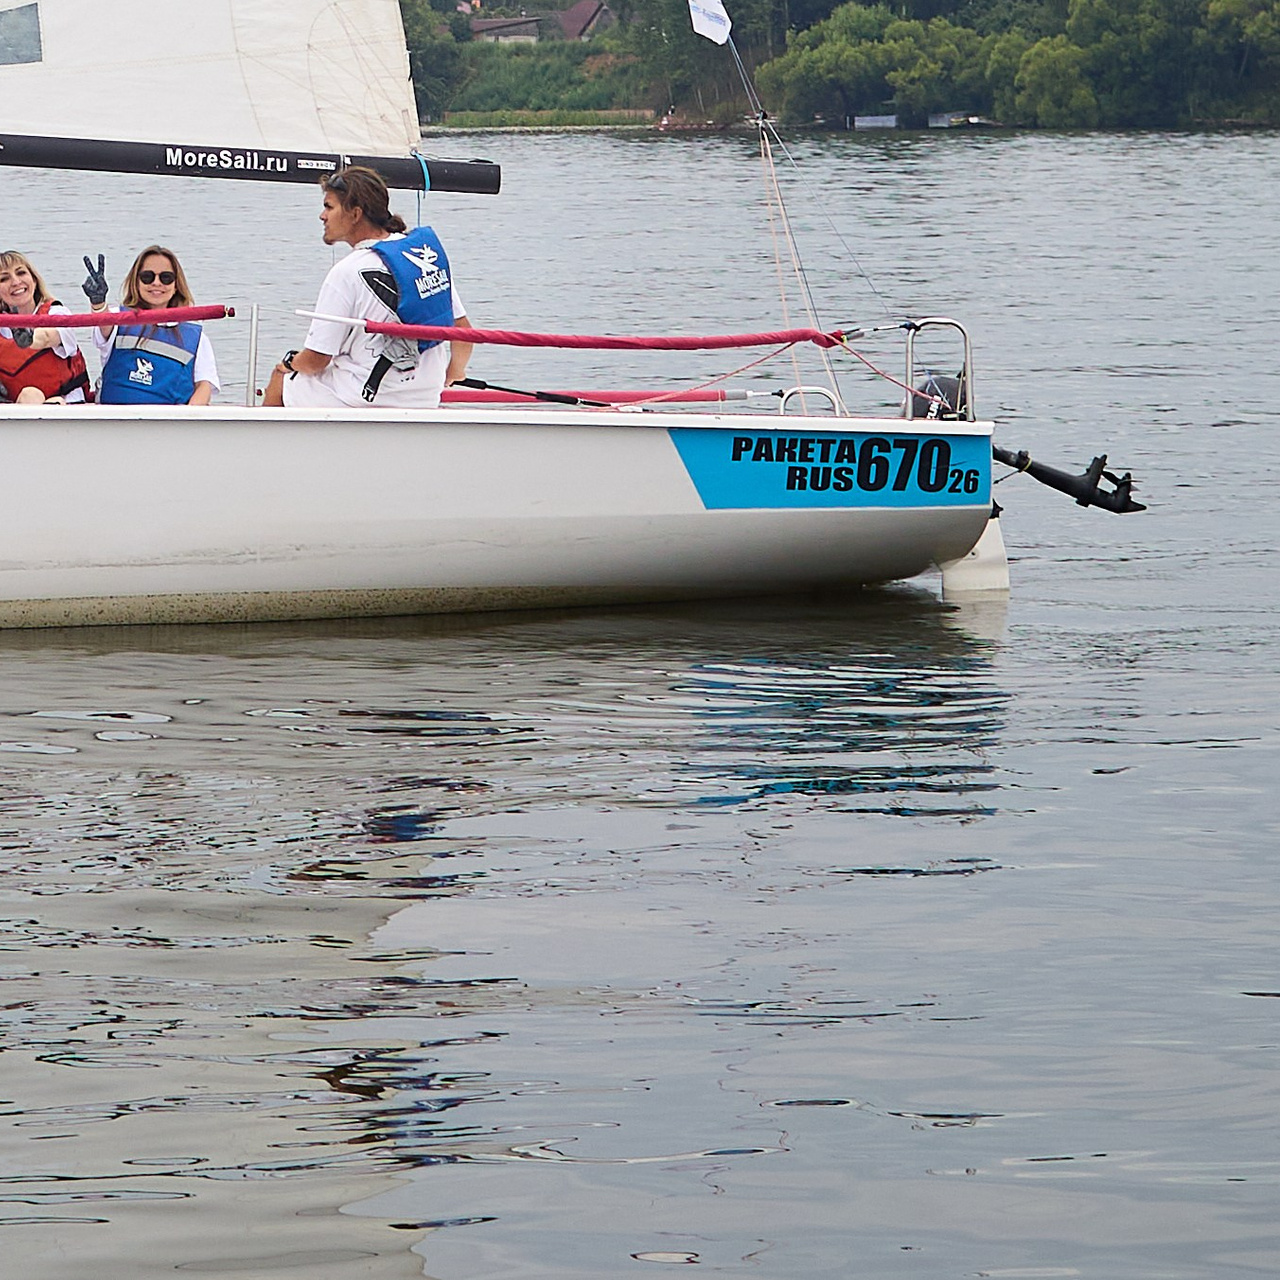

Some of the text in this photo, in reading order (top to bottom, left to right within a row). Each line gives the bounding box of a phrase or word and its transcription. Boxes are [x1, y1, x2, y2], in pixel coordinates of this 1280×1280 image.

[166, 147, 288, 172] MoreSail.ru
[857, 437, 952, 493] 670
[786, 466, 980, 494] RUS 26
